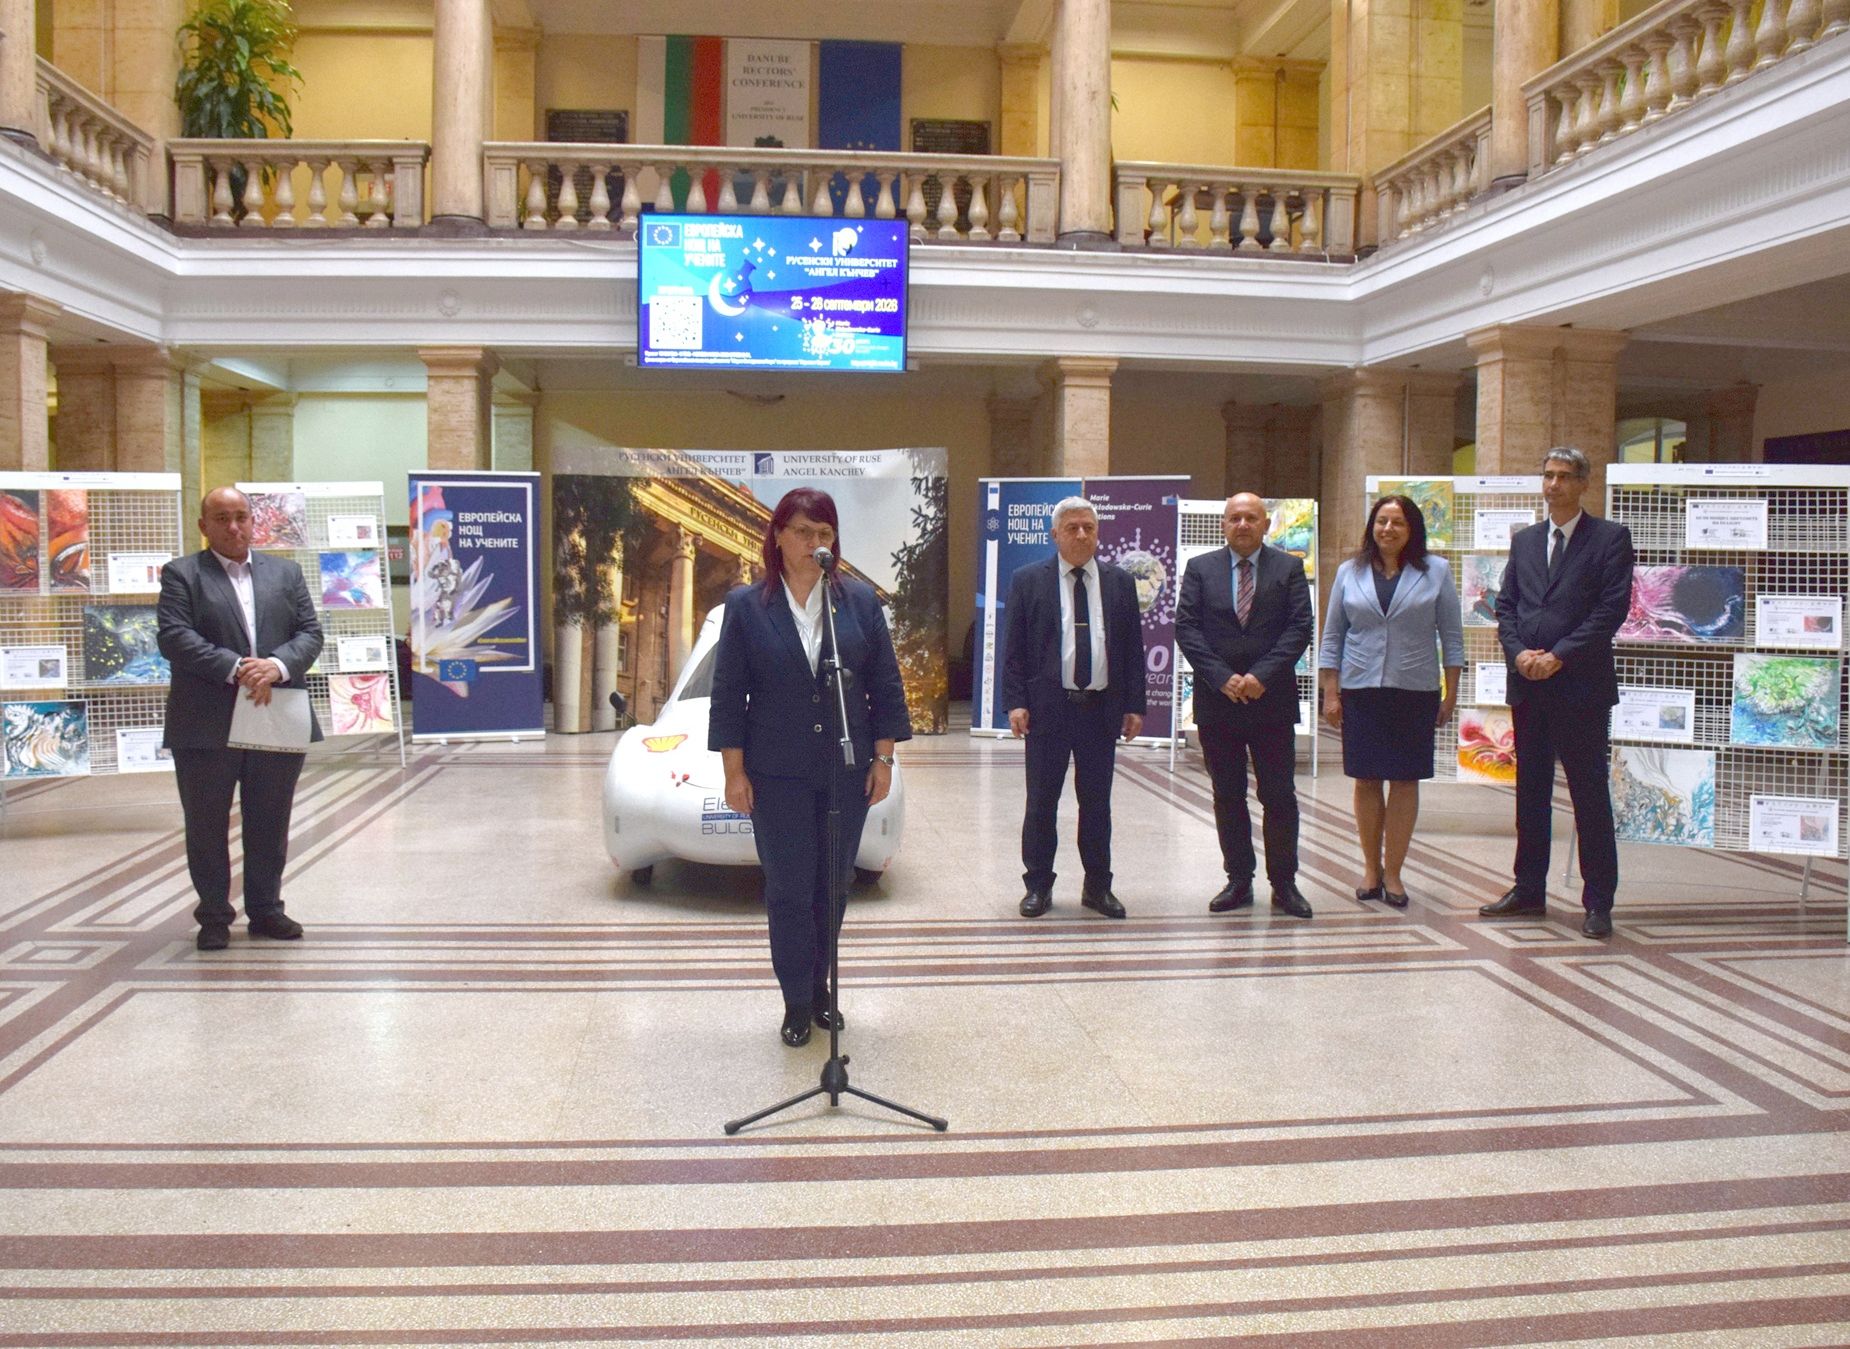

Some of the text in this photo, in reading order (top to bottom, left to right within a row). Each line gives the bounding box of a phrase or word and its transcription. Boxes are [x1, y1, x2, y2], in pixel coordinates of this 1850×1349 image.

[747, 54, 790, 63] DANUBE
[732, 79, 804, 89] CONFERENCE
[684, 221, 744, 239] ЕВРОПЕЙСКА
[684, 252, 727, 268] УЧЕНИТЕ
[786, 256, 898, 268] РУСЕНСКИ УНИВЕРСИТЕТ
[783, 455, 882, 464] UNIVERSITY OF RUSE
[783, 467, 866, 476] ANGEL KANCHEV
[1008, 502, 1055, 517] ЕВРОПЕЙС
[459, 511, 522, 523] ЕВРОПЕЙСКА
[1007, 518, 1044, 531] НОЩ НА
[459, 525, 483, 537] НОЩ
[459, 538, 519, 548] НА УЧЕНИТЕ
[1007, 532, 1049, 545] УЧЕНИТЕ
[1144, 645, 1170, 672] 0
[1146, 673, 1173, 685] ear
[703, 797, 728, 811] Ele
[702, 822, 753, 835] BULG
